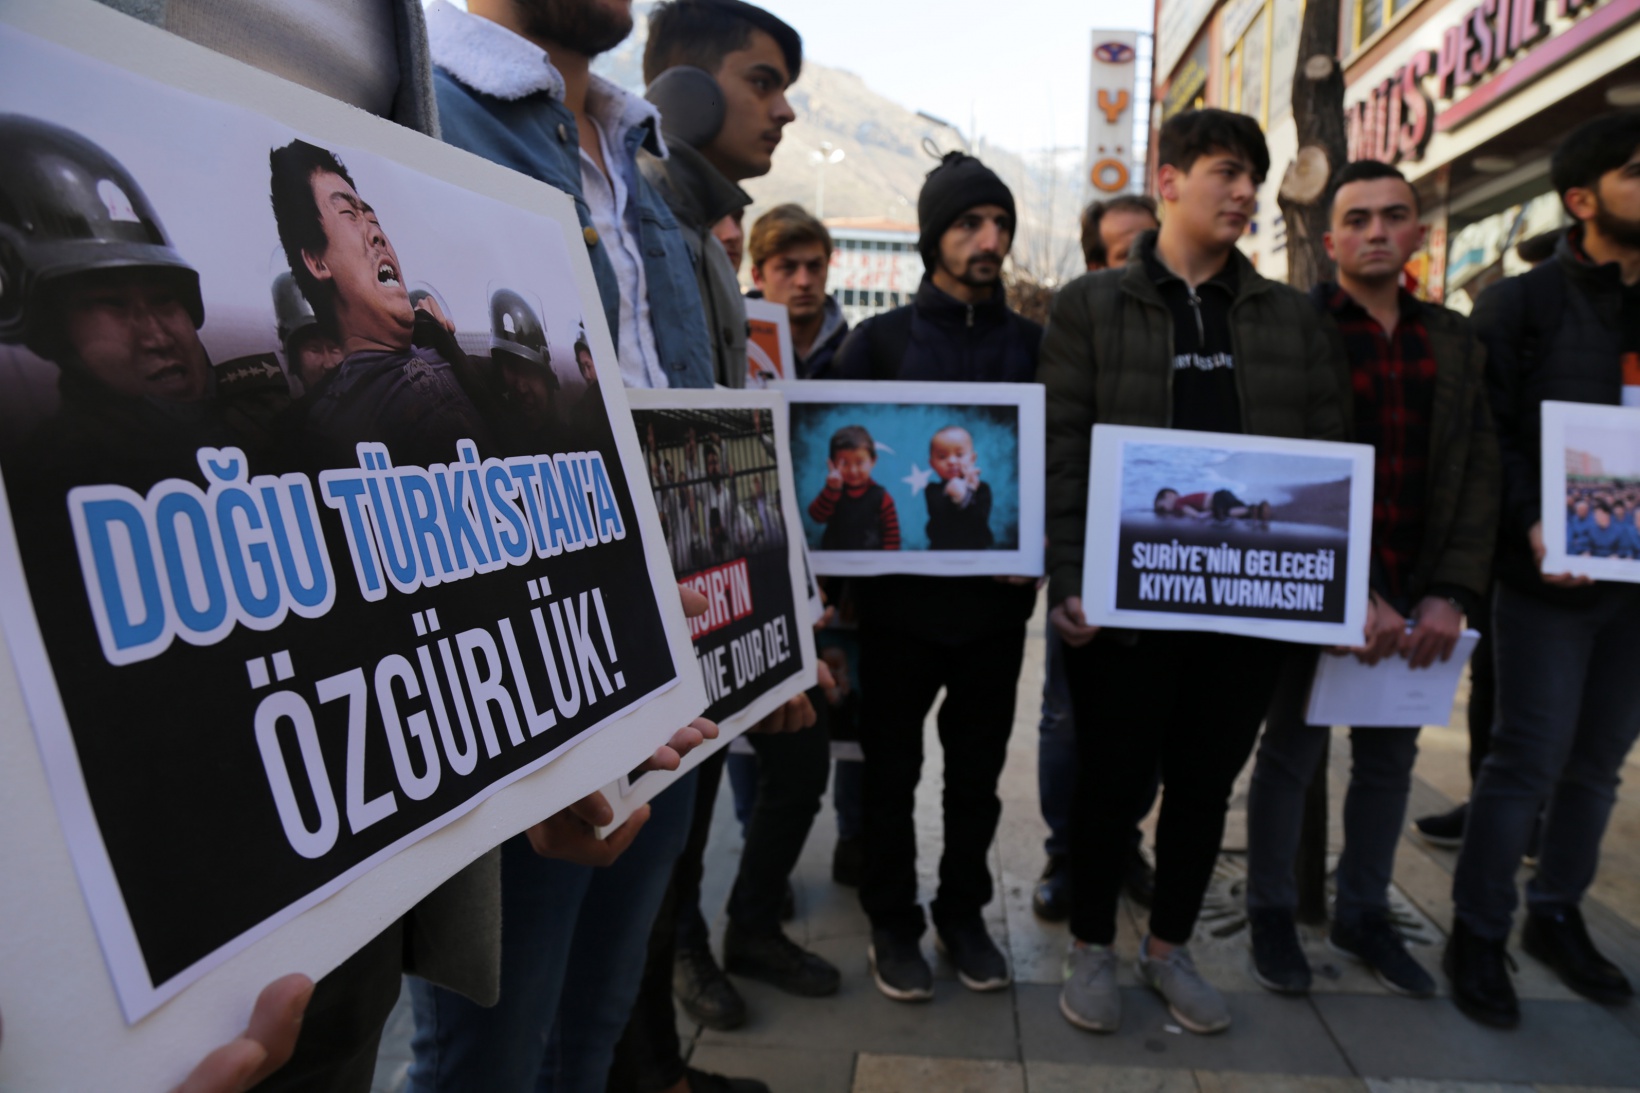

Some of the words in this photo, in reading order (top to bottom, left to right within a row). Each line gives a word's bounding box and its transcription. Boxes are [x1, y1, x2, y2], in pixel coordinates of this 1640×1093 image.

[68, 447, 336, 666] DOĞU
[319, 438, 627, 602] TÜRKİSTAN'A
[1132, 538, 1242, 576] SURİYE'NİN
[1244, 548, 1335, 582] GELECEĞİ
[1139, 572, 1207, 604] KIYIYA
[1211, 577, 1325, 612] VURMASIN!
[730, 628, 775, 690] DUR
[763, 614, 791, 670] DE!
[246, 575, 627, 860] ÖZGÜRLÜK!
